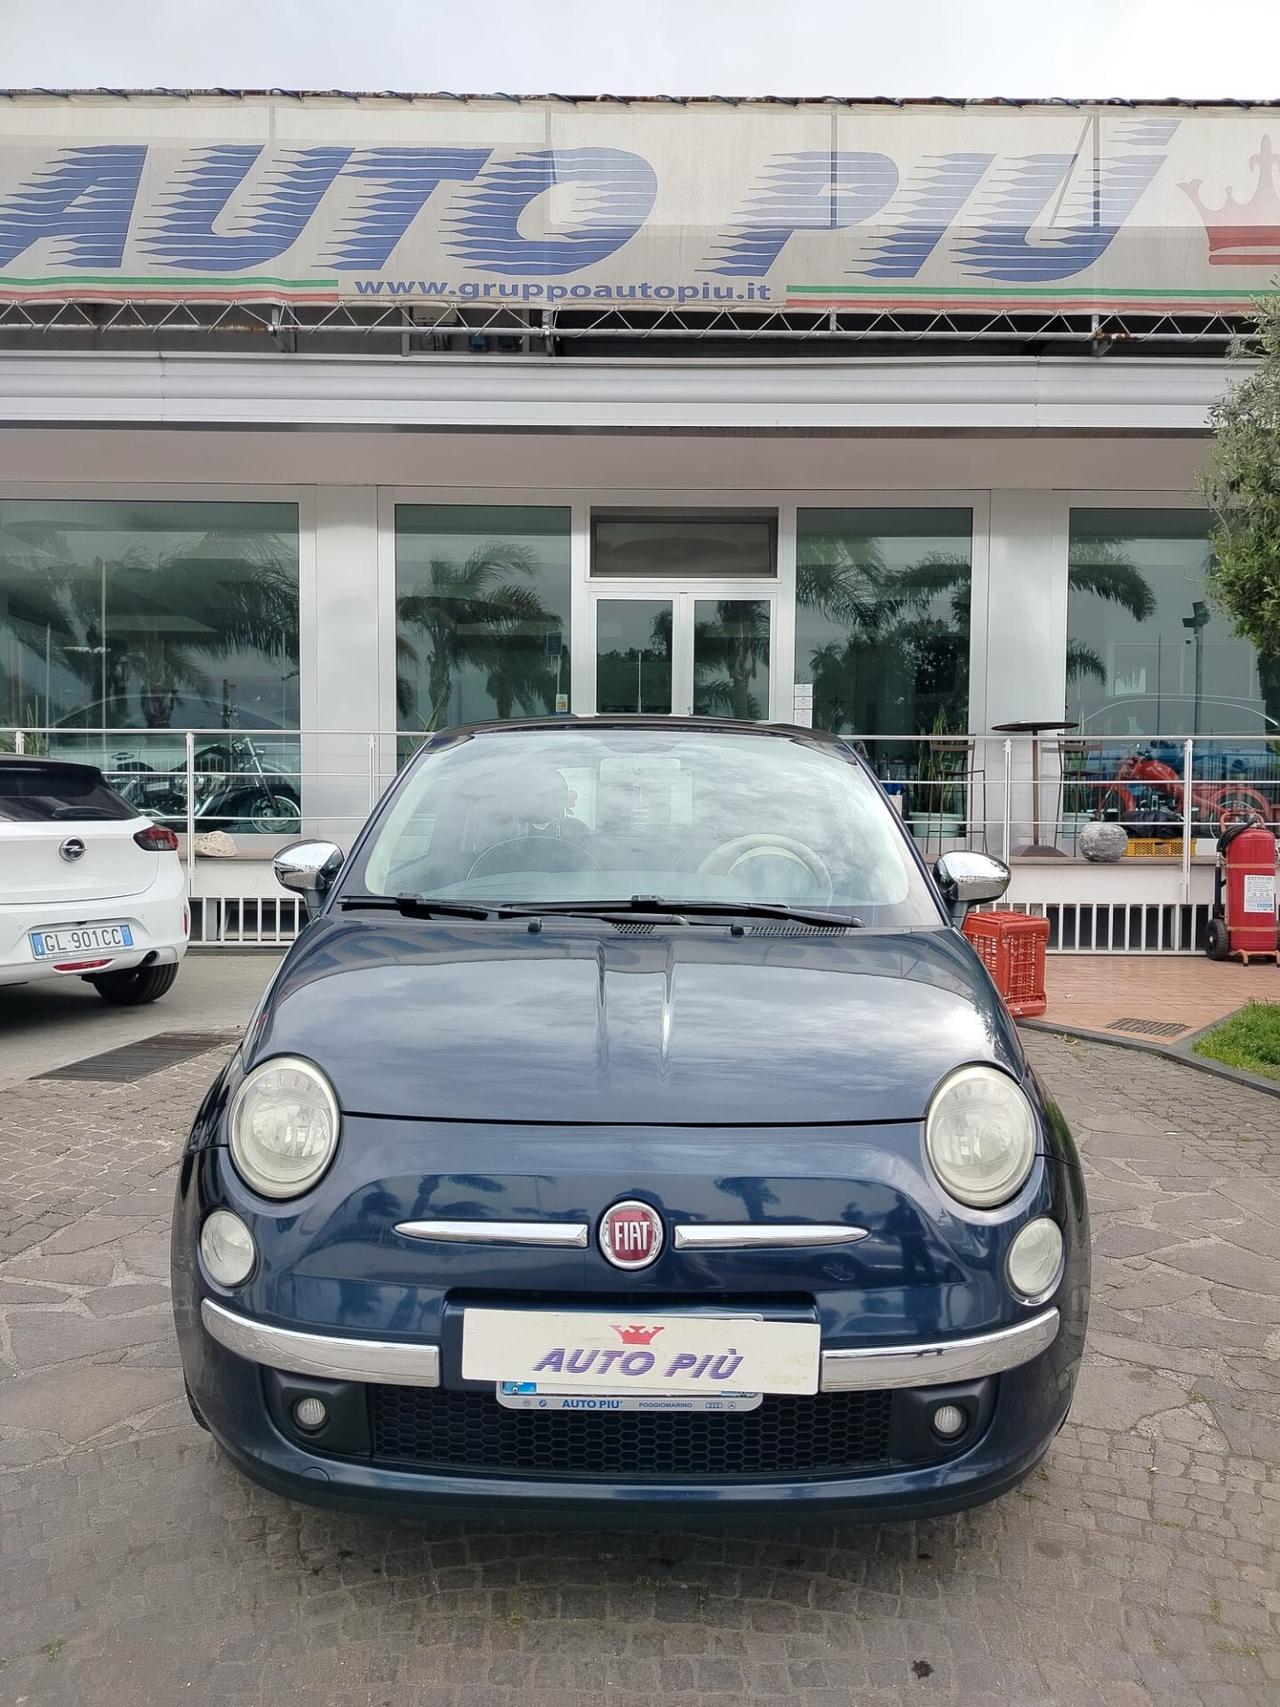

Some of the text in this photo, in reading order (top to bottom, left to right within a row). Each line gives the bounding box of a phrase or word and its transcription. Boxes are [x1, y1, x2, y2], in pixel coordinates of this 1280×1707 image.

[0, 143, 657, 276] AUTO
[354, 280, 772, 304] www.gruppoautopiu.it
[614, 1221, 650, 1251] FIAT
[532, 1347, 745, 1380] AUTO PIÙ
[561, 1399, 597, 1409] AUTO
